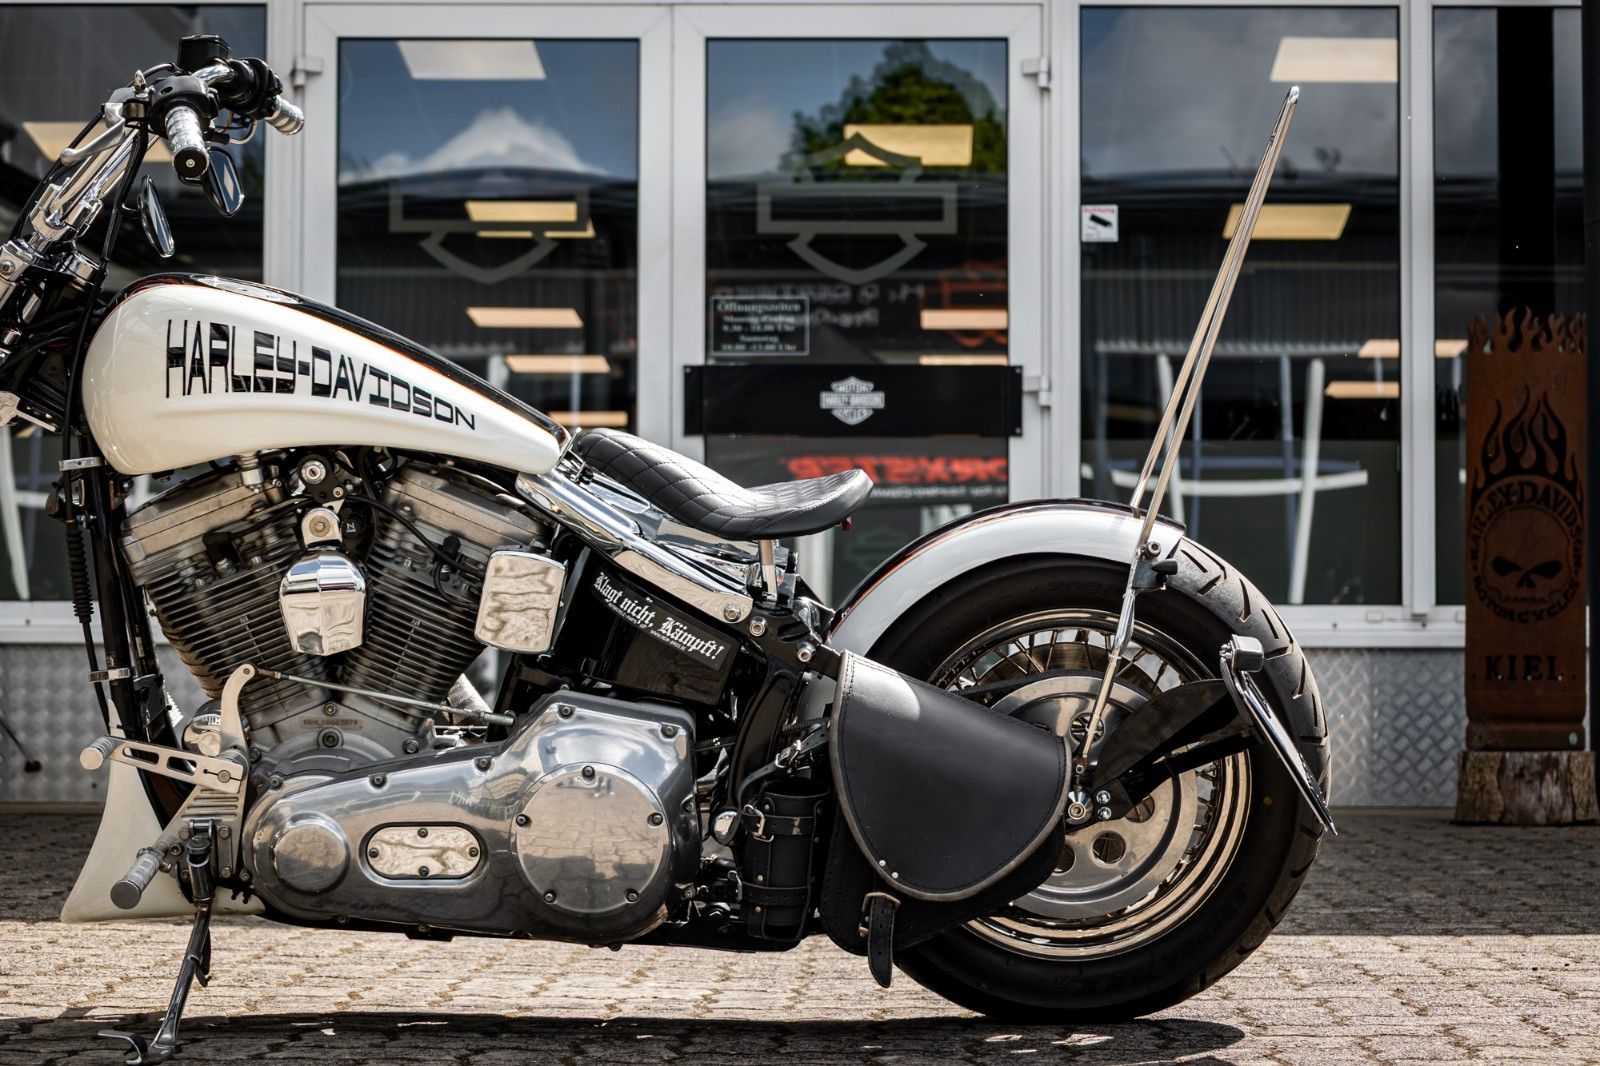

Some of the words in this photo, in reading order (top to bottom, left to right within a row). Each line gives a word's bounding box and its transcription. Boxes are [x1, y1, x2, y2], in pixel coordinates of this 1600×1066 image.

[166, 319, 476, 431] HARLEY-DAVIDSON
[593, 572, 623, 604] Klagt
[620, 597, 656, 627] nicht,
[657, 617, 725, 660] Kämpft!
[1473, 575, 1580, 624] MOTORCYCLES
[1484, 655, 1564, 681] KIEL
